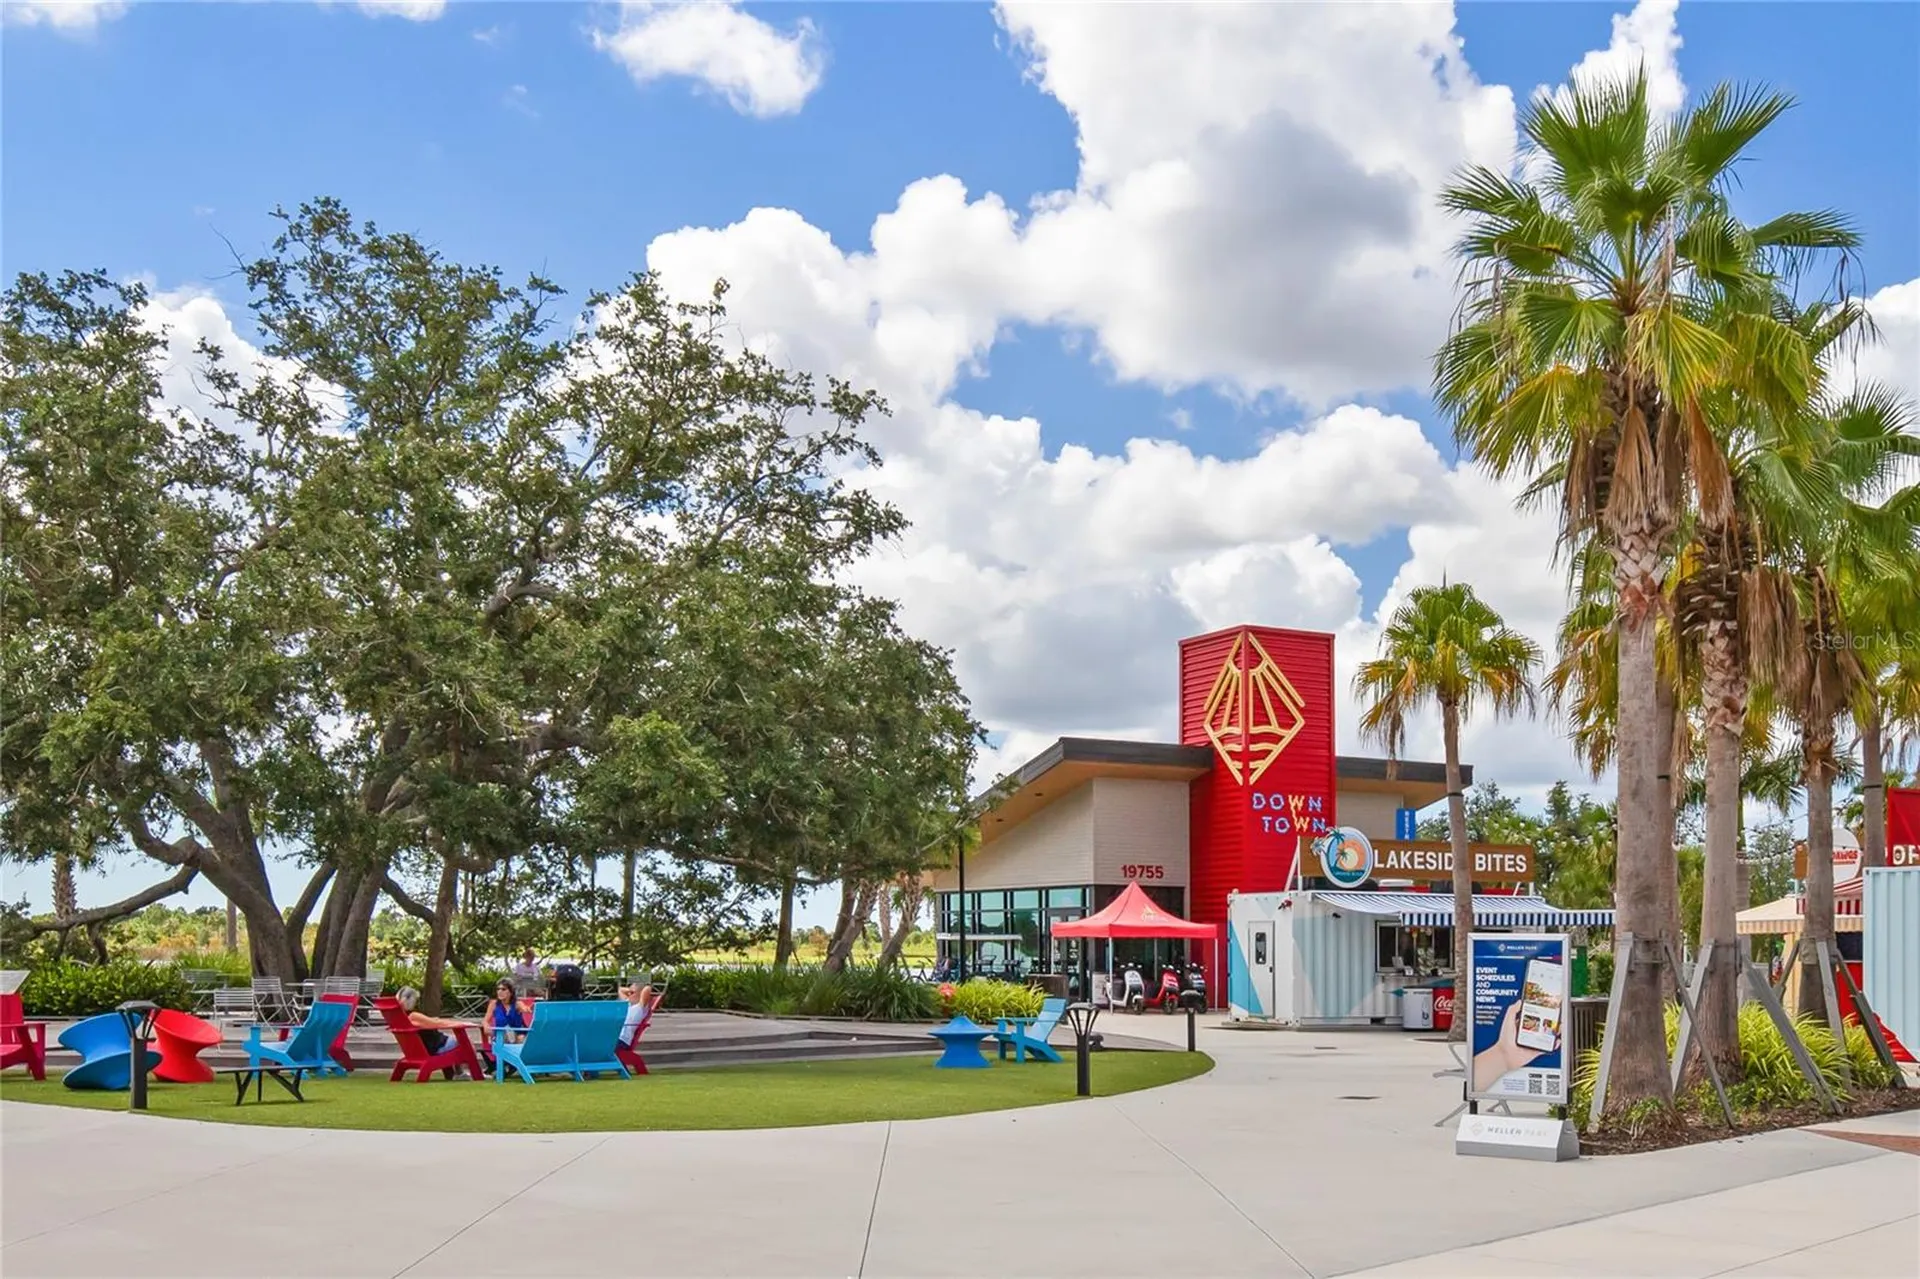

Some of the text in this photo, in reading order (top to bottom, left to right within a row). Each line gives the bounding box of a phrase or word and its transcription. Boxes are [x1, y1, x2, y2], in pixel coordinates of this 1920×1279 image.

[1252, 793, 1322, 812] DOWN
[1262, 816, 1326, 833] TOWN
[1374, 849, 1527, 873] LAKESID BITES
[1121, 864, 1164, 879] 19755
[1476, 974, 1516, 982] SCHEDULES
